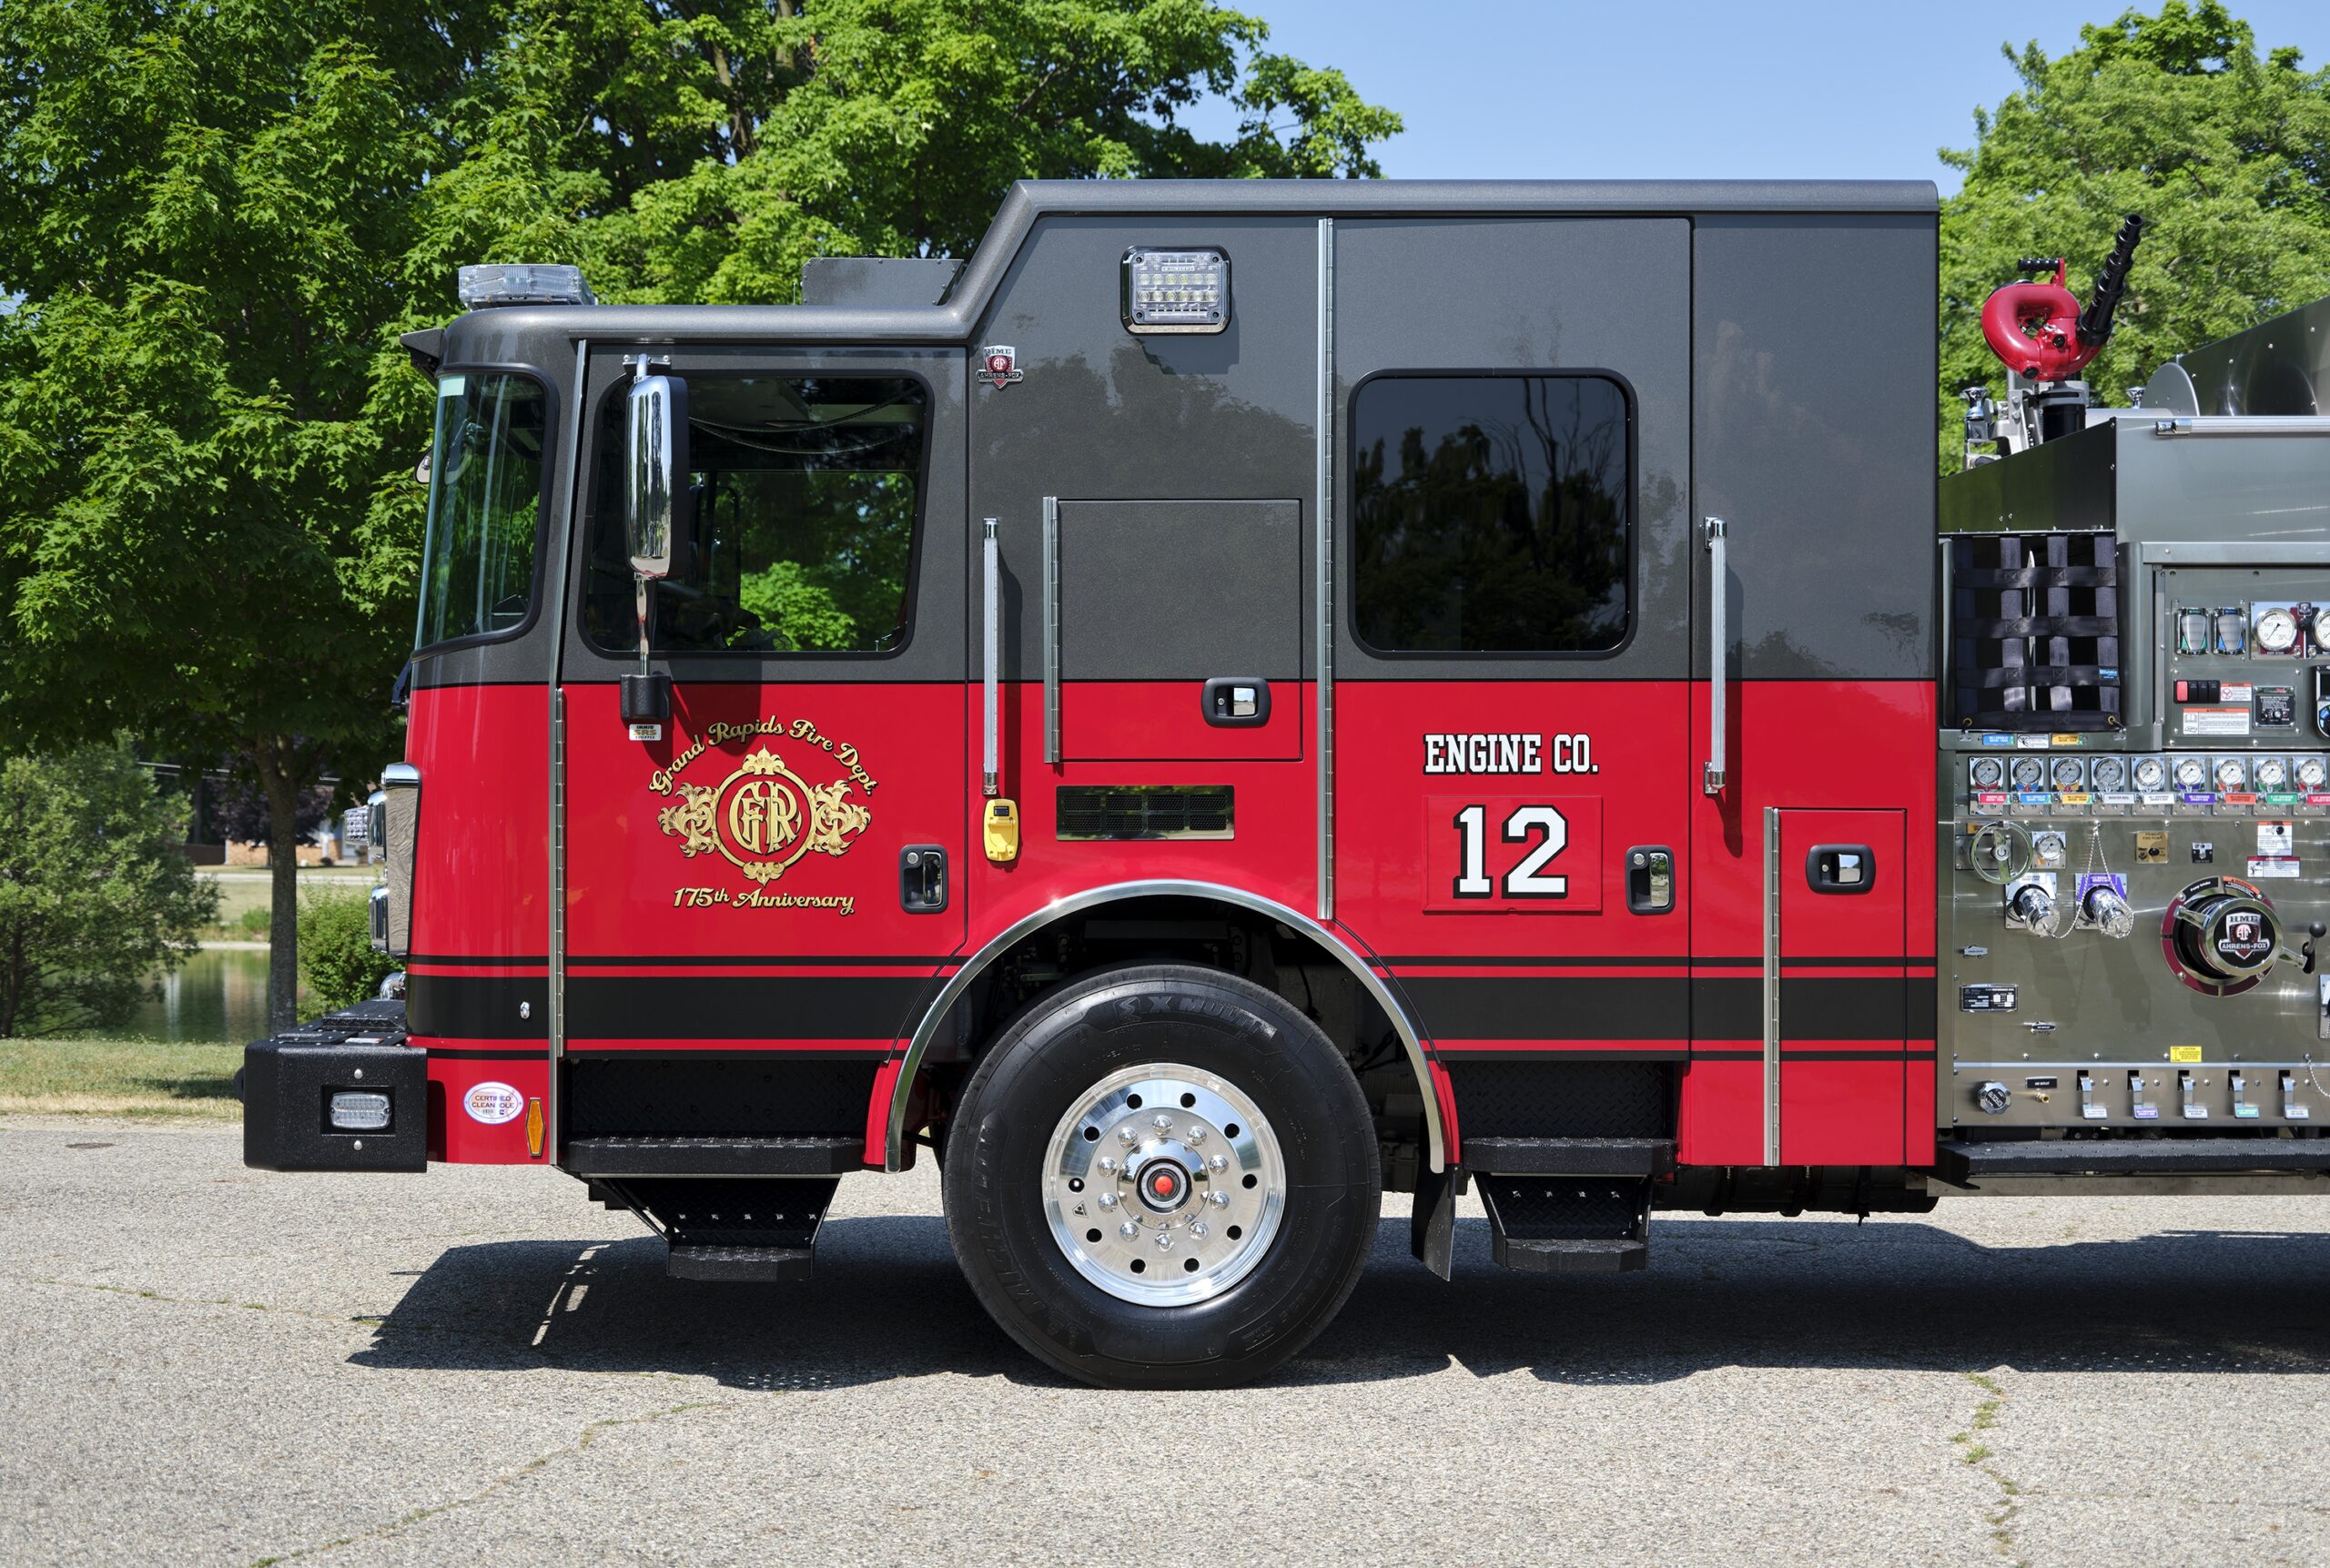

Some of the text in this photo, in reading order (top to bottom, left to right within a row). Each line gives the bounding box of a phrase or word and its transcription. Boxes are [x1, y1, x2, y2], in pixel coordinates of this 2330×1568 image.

[648, 715, 878, 795] Grand Rapids Fire Dept.
[1423, 733, 1598, 774] ENGINE CO.
[1454, 804, 1568, 899] 12
[673, 887, 855, 916] 175th Anniversary
[2229, 915, 2260, 923] HME
[2222, 942, 2267, 950] AHRENS-FOX
